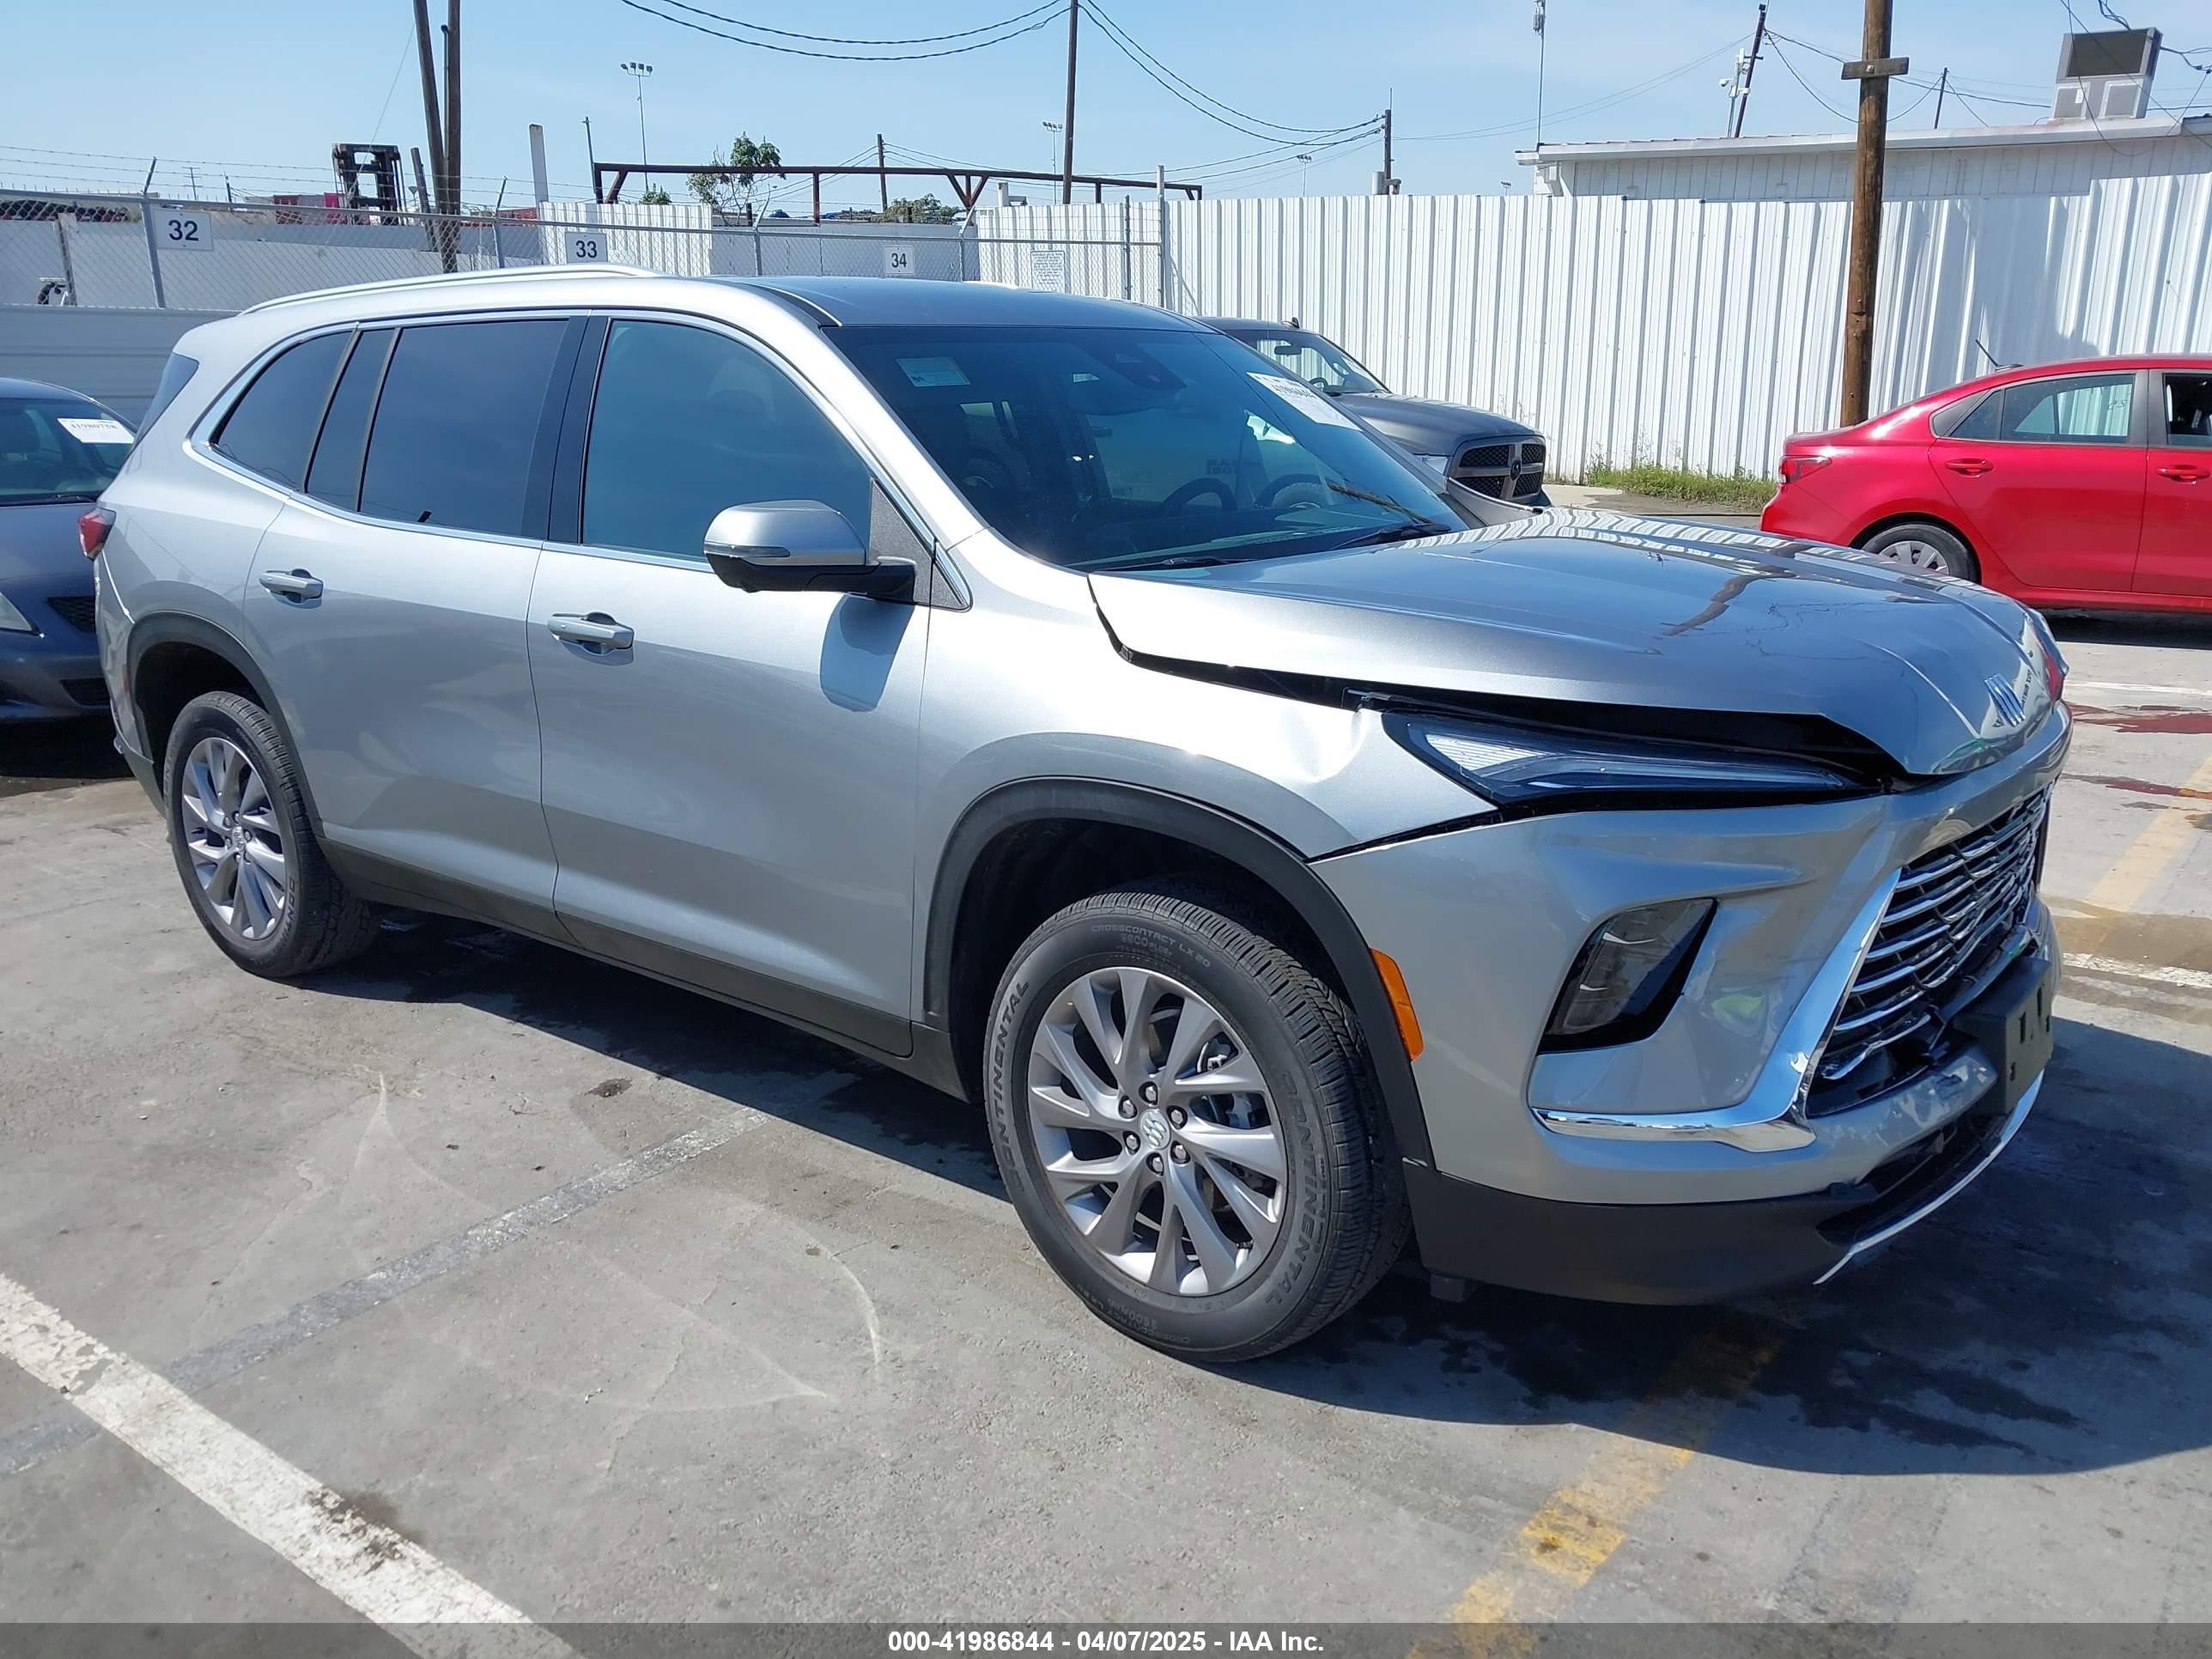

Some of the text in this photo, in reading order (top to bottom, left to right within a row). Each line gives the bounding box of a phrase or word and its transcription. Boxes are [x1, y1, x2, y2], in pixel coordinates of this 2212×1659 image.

[168, 219, 199, 241] 32
[575, 240, 598, 258] 33
[891, 252, 908, 268] 34
[1266, 1070, 1319, 1305] CONTINENTAL
